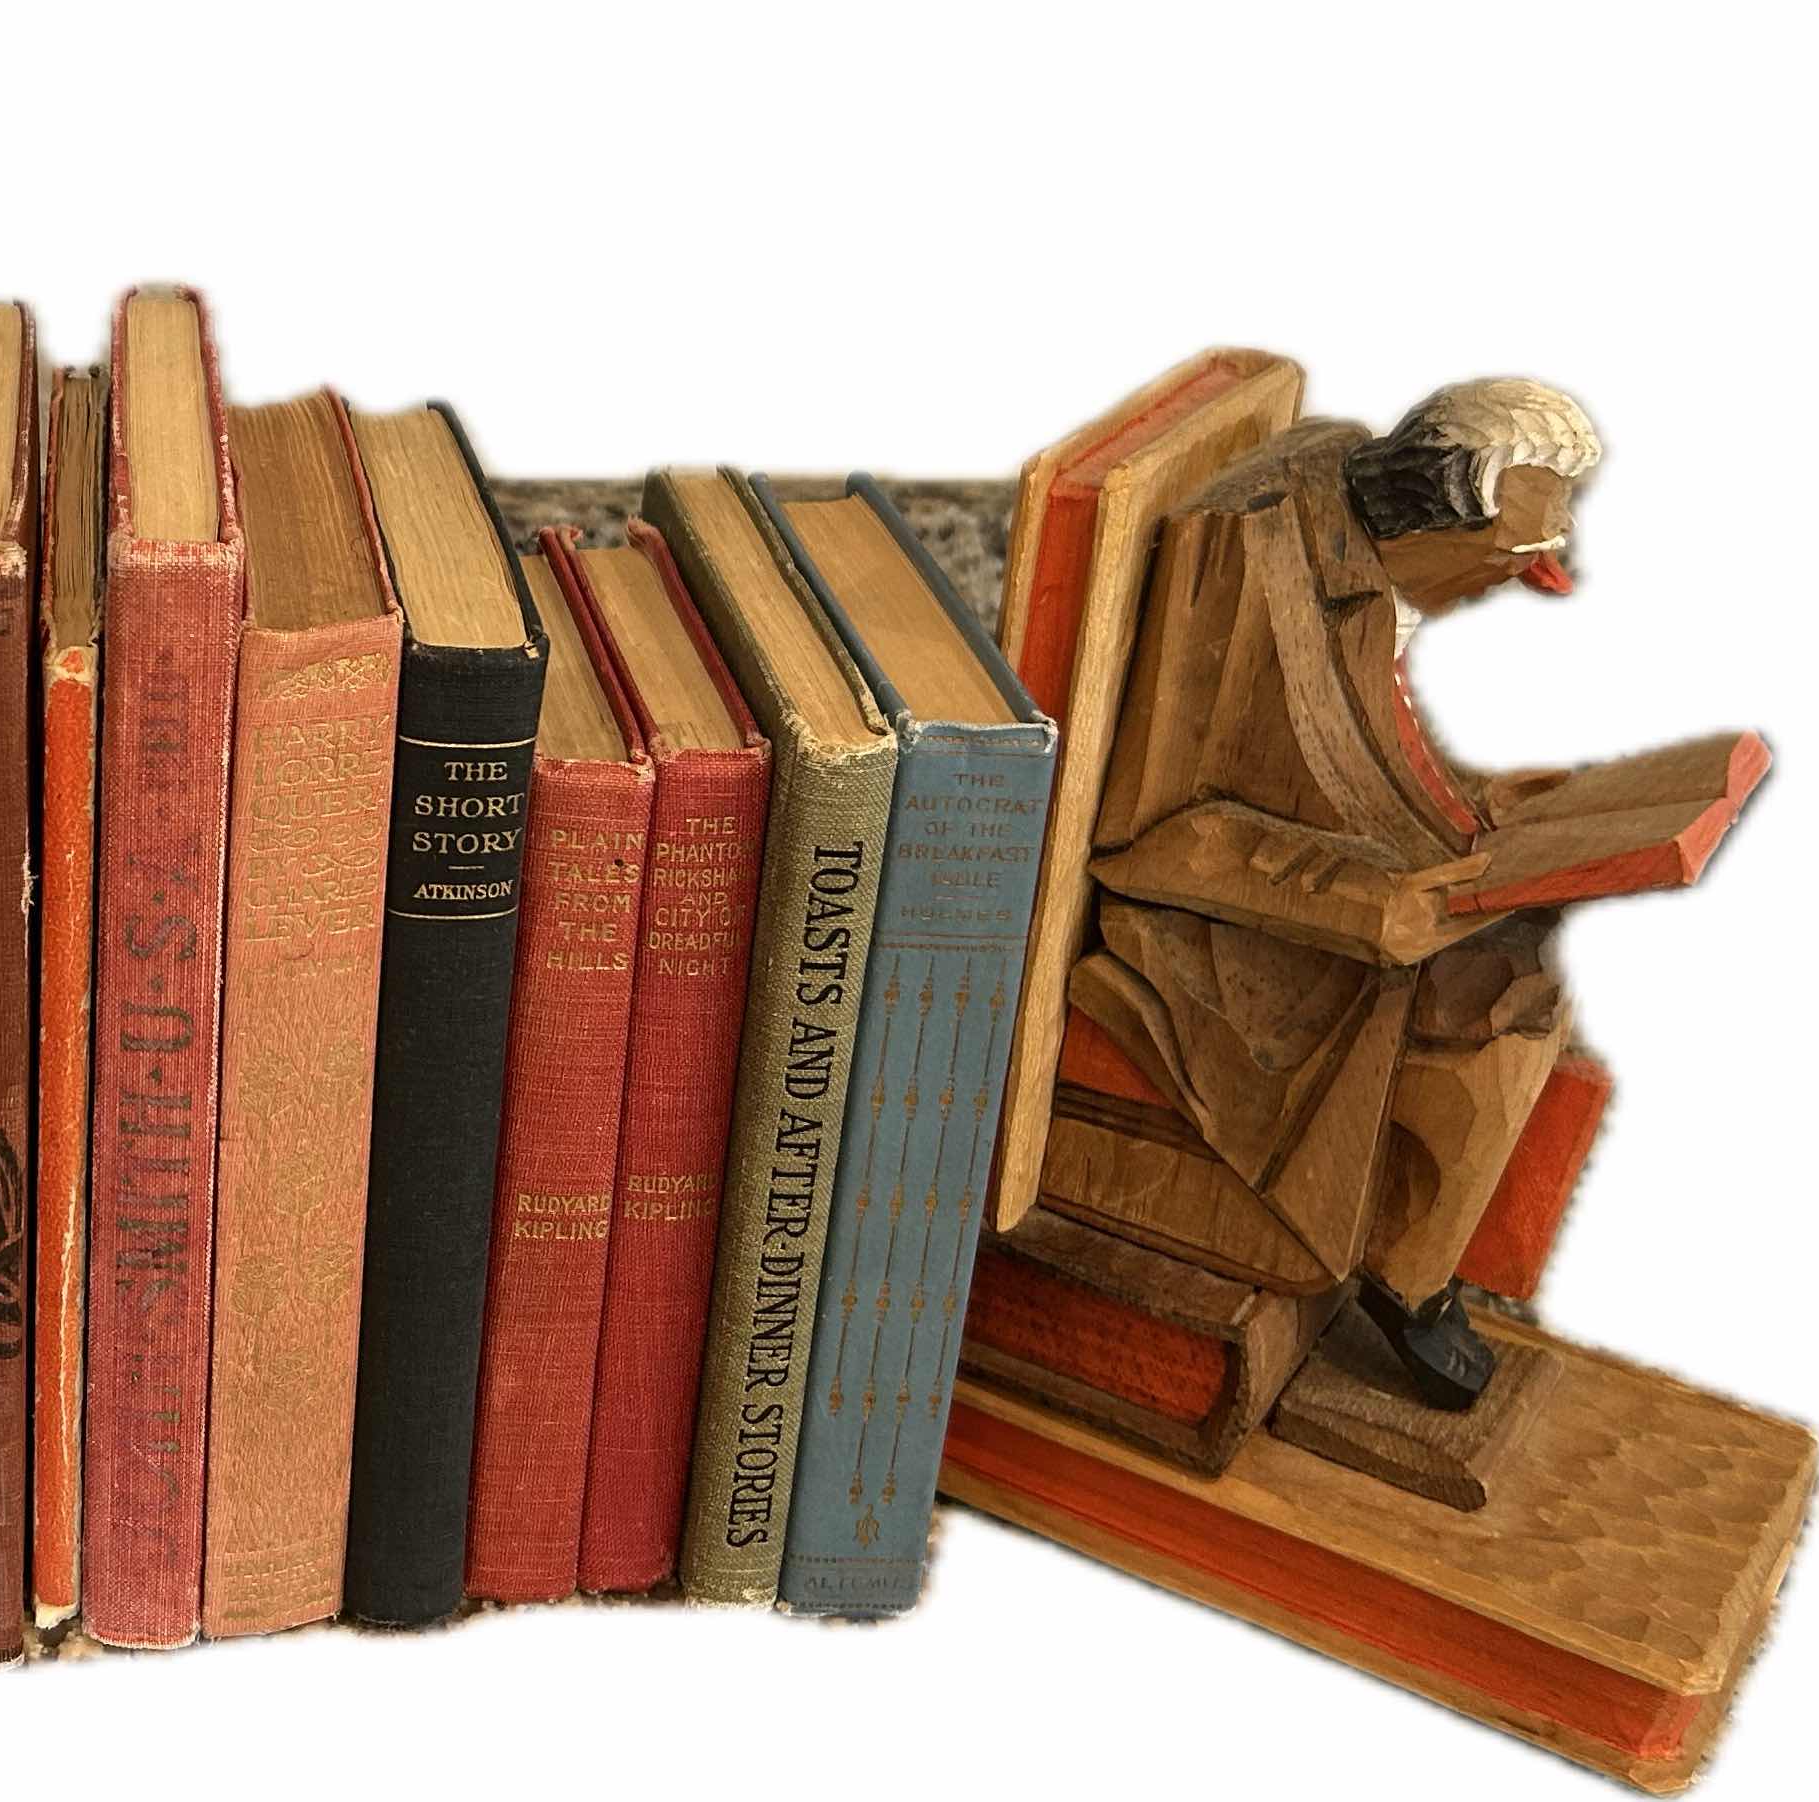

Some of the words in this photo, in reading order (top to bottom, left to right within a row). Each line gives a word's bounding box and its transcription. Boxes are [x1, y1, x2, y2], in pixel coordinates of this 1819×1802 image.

[444, 761, 508, 782] THE
[950, 772, 1006, 788] THE
[414, 792, 525, 818] SHORT
[905, 794, 1044, 816] AUTOCRAT
[686, 816, 737, 836] THE
[924, 820, 953, 837] OF
[969, 821, 1013, 838] THE
[412, 827, 524, 855] STORY
[552, 830, 644, 851] PLAIN
[899, 842, 1036, 864] BREAKFAST
[547, 861, 640, 884] TALES
[412, 879, 514, 901] ATKINSON
[680, 891, 729, 906] AND
[554, 892, 631, 914] FROM
[654, 906, 712, 928] CITY
[794, 840, 864, 1006] TOASTS
[558, 920, 619, 943] THE
[546, 951, 629, 971] HILLS
[657, 957, 731, 976] NIGHT
[784, 1016, 838, 1101] AND
[518, 1192, 611, 1215] RUDYARD
[513, 1218, 608, 1240] KIPLING
[744, 1107, 823, 1393] AFTER-DINNER
[726, 1402, 784, 1549] STORIES
